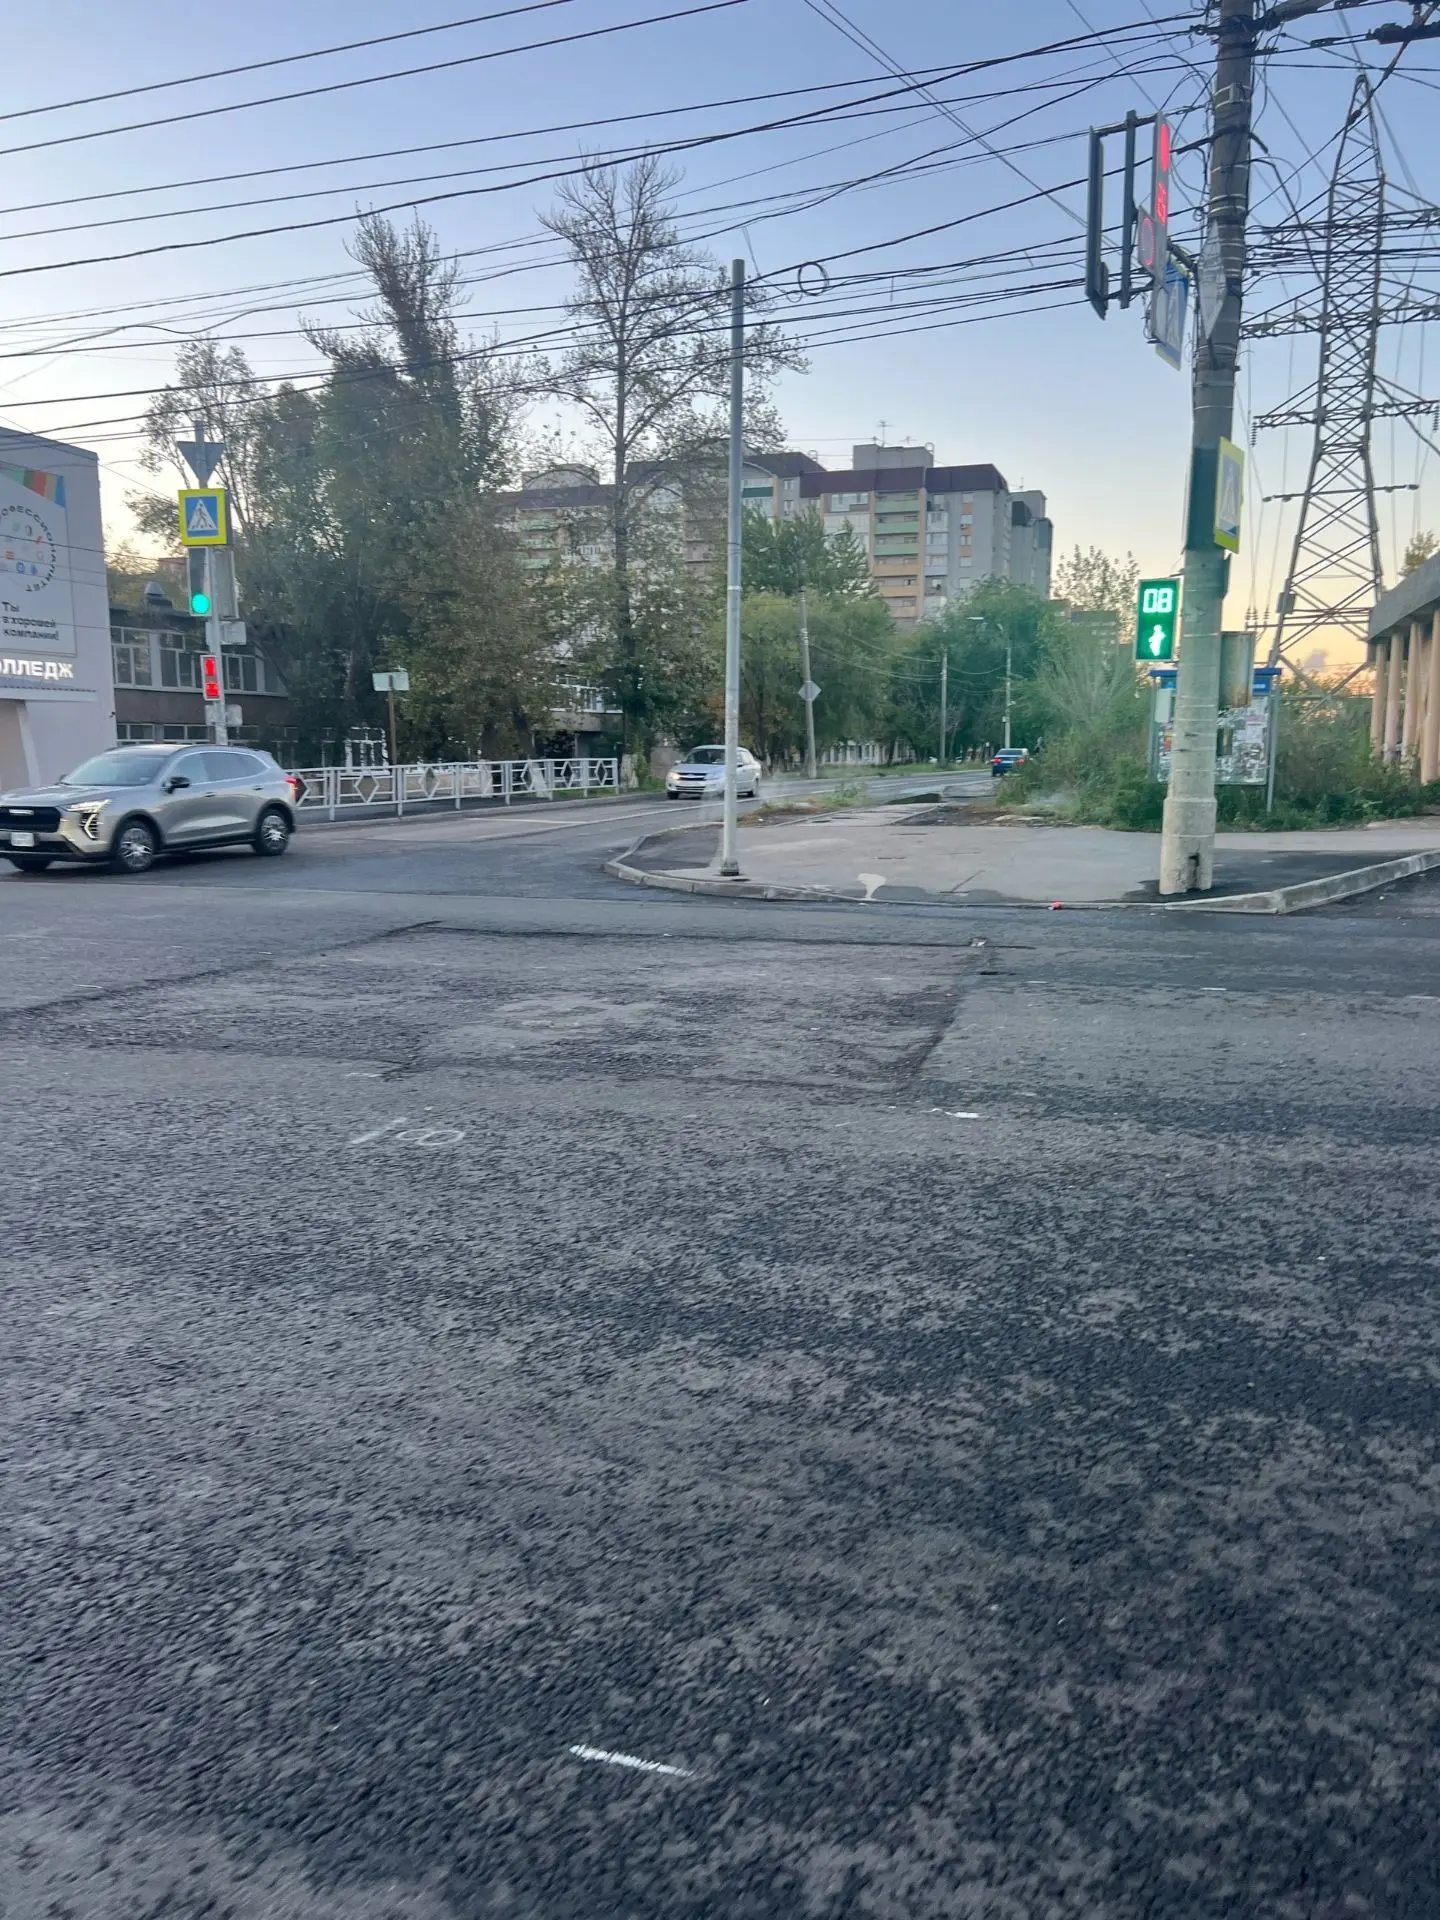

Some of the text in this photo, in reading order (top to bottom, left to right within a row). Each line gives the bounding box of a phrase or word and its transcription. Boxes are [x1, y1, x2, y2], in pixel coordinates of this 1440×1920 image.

[1, 600, 20, 613] Ты
[1143, 588, 1173, 613] 08
[0, 658, 74, 680] ЛЛЕДЖ
